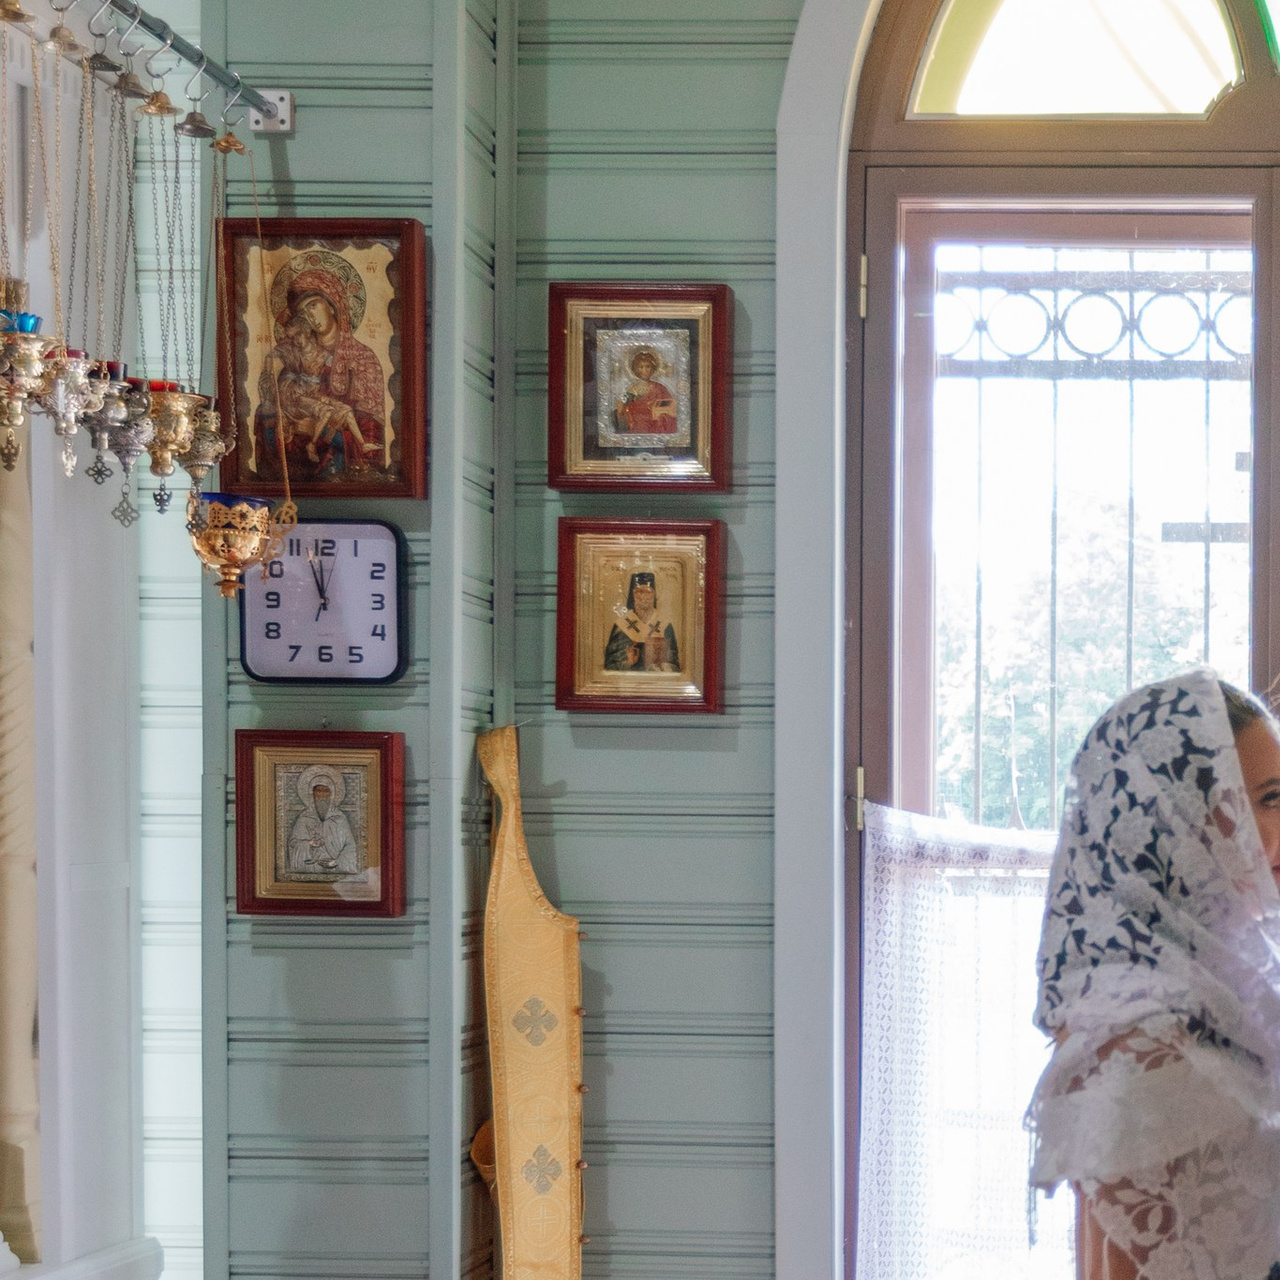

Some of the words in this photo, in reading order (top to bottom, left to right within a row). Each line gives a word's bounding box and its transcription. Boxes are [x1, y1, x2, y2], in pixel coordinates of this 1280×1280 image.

[289, 538, 300, 556] 11
[315, 539, 336, 557] 12
[353, 539, 358, 557] 1
[370, 562, 386, 580] 2
[265, 591, 281, 609] 9
[371, 593, 385, 611] 3
[265, 621, 281, 639] 8
[371, 624, 386, 641] 4
[288, 645, 302, 662] 7
[318, 645, 333, 663] 6
[348, 646, 364, 663] 5
